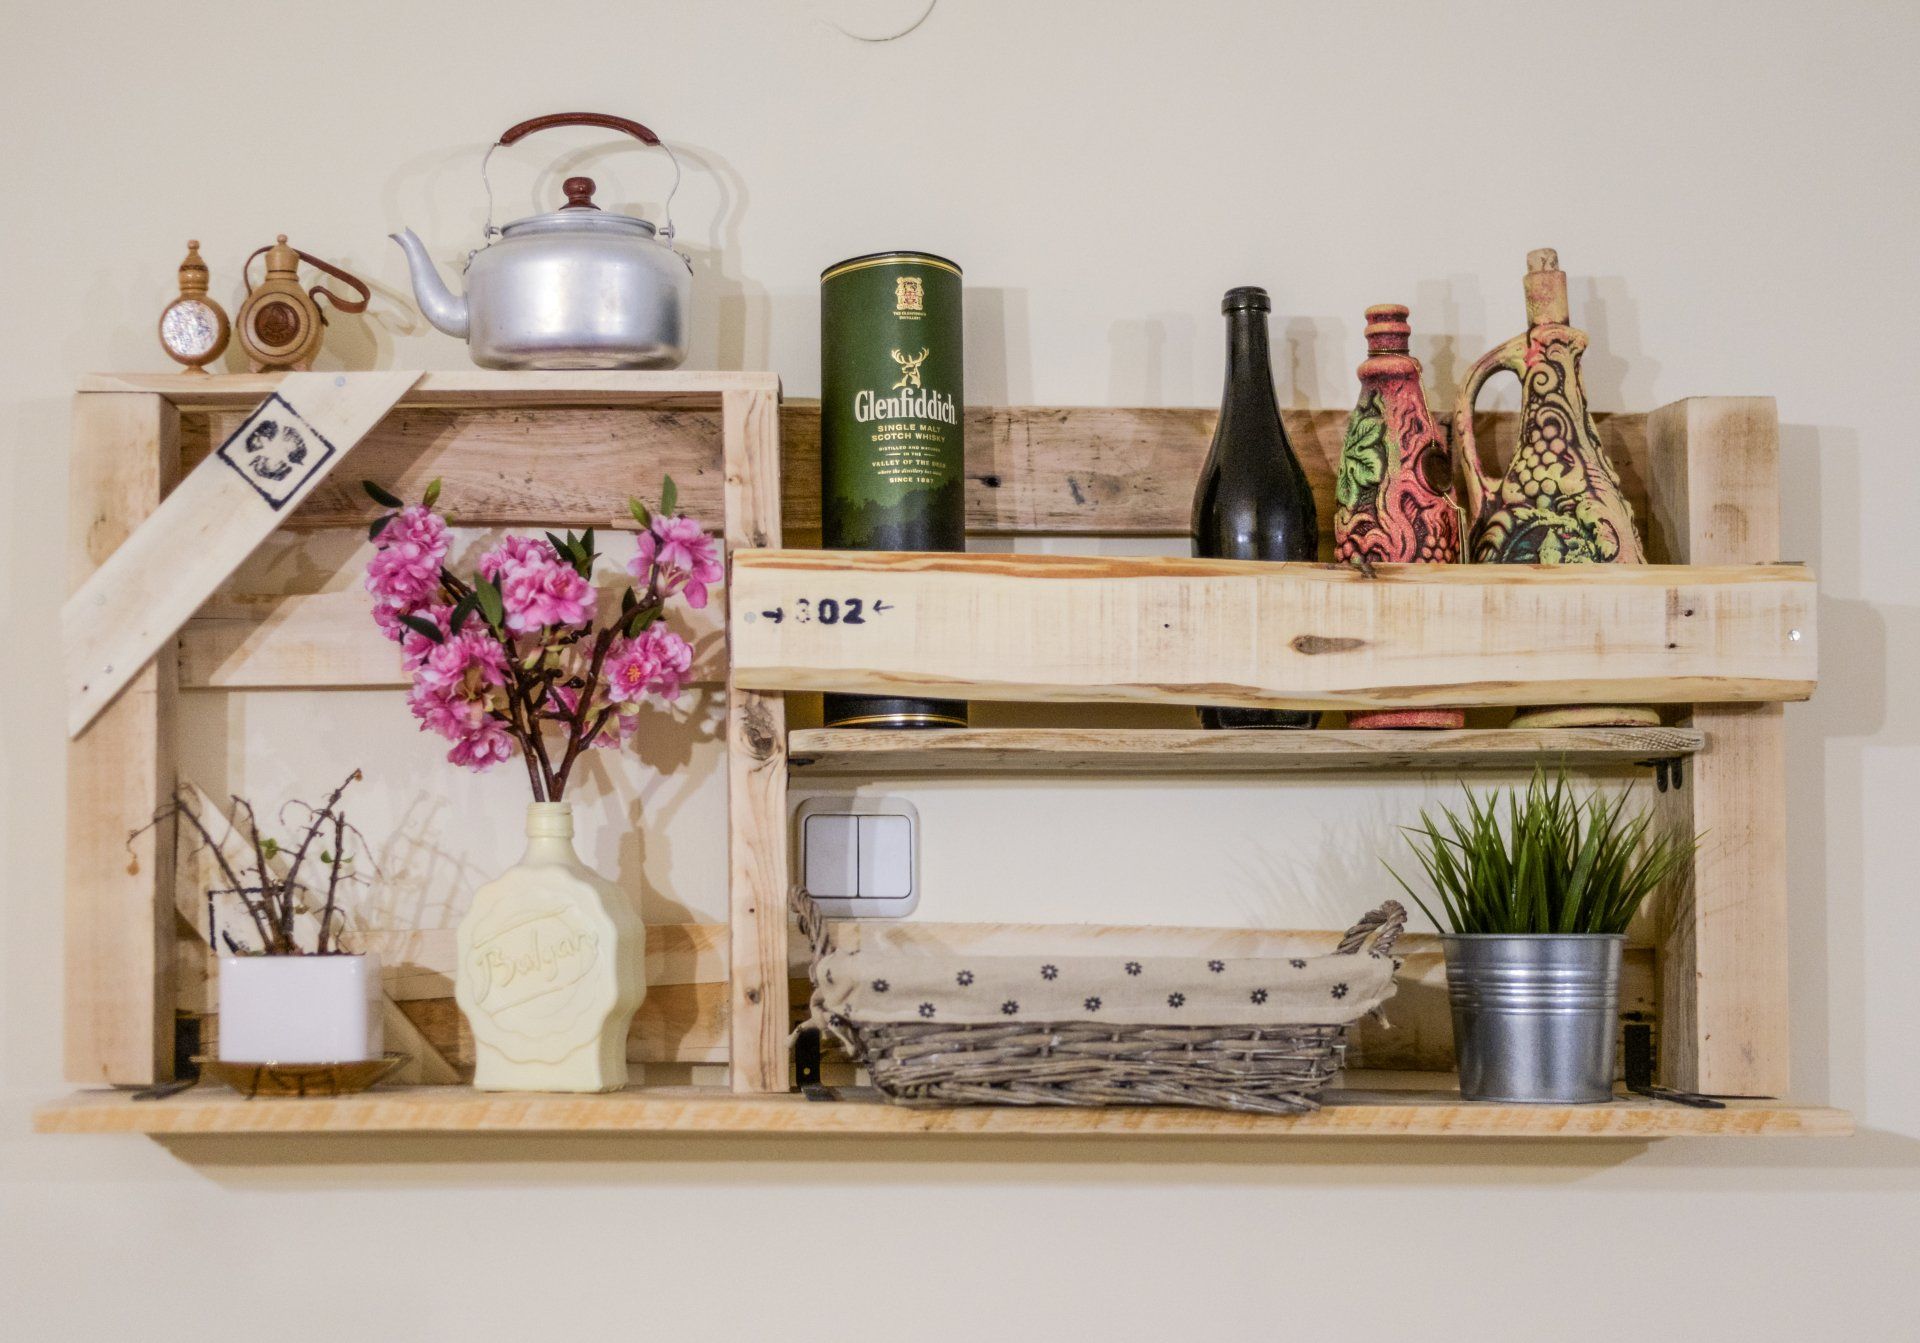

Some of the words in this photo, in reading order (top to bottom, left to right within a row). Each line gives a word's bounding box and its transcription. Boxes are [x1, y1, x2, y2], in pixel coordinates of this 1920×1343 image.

[855, 388, 956, 425] Glenfiddich
[878, 424, 916, 432] SINGLE
[920, 424, 941, 433] MALT
[872, 433, 912, 442] SCOTCH
[916, 433, 945, 443] WHISKY
